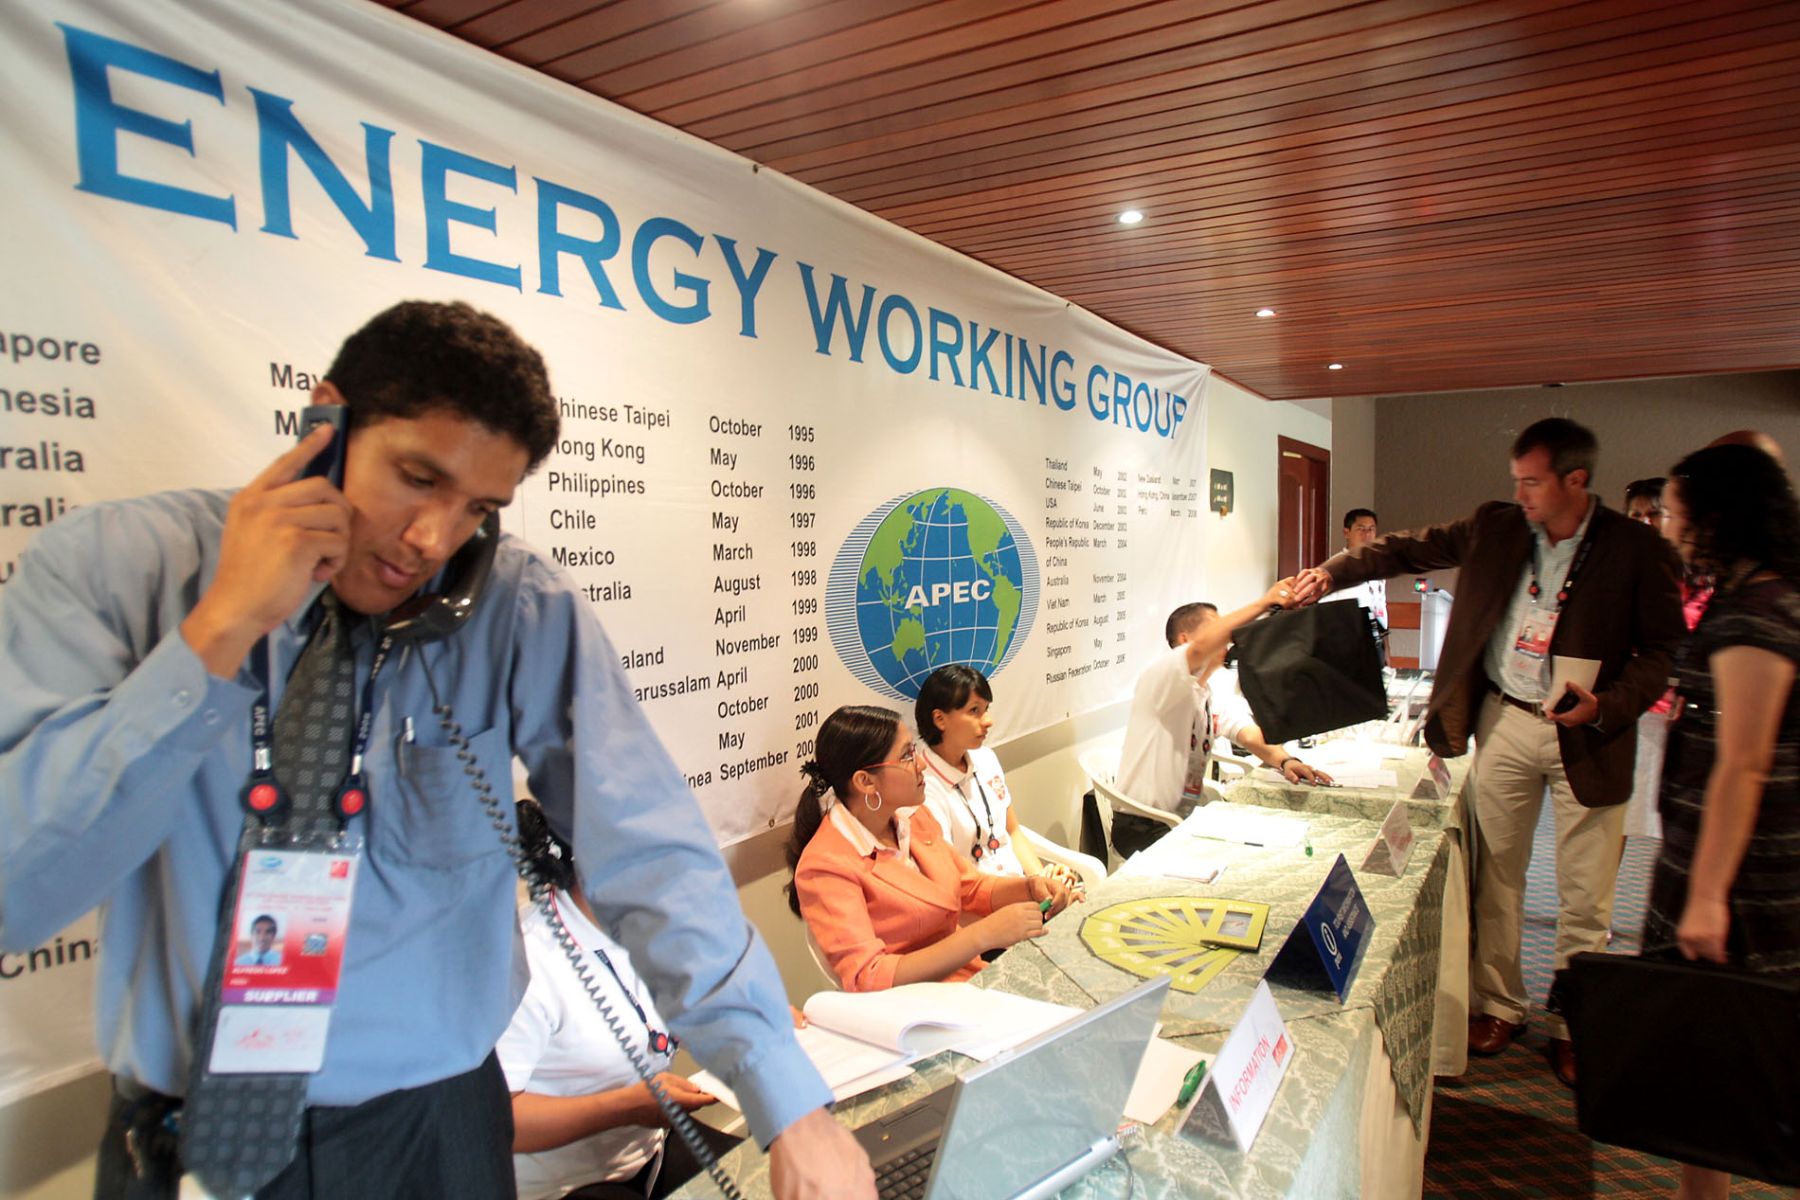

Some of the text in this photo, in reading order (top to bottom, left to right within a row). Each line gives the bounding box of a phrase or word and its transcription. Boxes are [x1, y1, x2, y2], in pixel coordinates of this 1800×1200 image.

[54, 21, 1187, 439] ENERGY WORKING GROUP
[560, 397, 814, 442] hinese Taipei October 1995
[602, 438, 645, 464] Kong
[710, 448, 737, 471] May
[789, 454, 815, 471] 1996
[1046, 458, 1067, 471] Thailand
[549, 471, 816, 500] Philippines October 1996
[1046, 478, 1066, 490] Chinese
[1068, 480, 1082, 491] Taipei
[1093, 484, 1110, 495] October
[1046, 498, 1057, 508] USA
[550, 509, 816, 533] Chile May 1997
[1046, 518, 1068, 529] Republic
[1093, 520, 1114, 530] December
[552, 542, 816, 567] Mexico March 1998
[1093, 538, 1106, 547] March
[1053, 556, 1067, 566] China
[714, 574, 760, 597] August
[791, 570, 817, 586] 1998
[1047, 576, 1068, 586] Australia
[904, 579, 990, 609] APEC
[1058, 599, 1069, 608] Nam
[715, 599, 817, 625] April 1999
[1047, 620, 1068, 633] Republic
[716, 633, 780, 656] November
[792, 626, 818, 645] 1999
[1047, 645, 1071, 658] Singapore
[717, 667, 747, 689] April
[793, 655, 818, 673] 2000
[1046, 670, 1067, 684] Russian
[718, 683, 819, 718] October 2000
[719, 710, 819, 750] May 2001
[720, 749, 788, 781] September
[796, 739, 817, 759] 200
[244, 990, 319, 1002] SUPPLIER
[1228, 1034, 1271, 1114] INFORMATION
